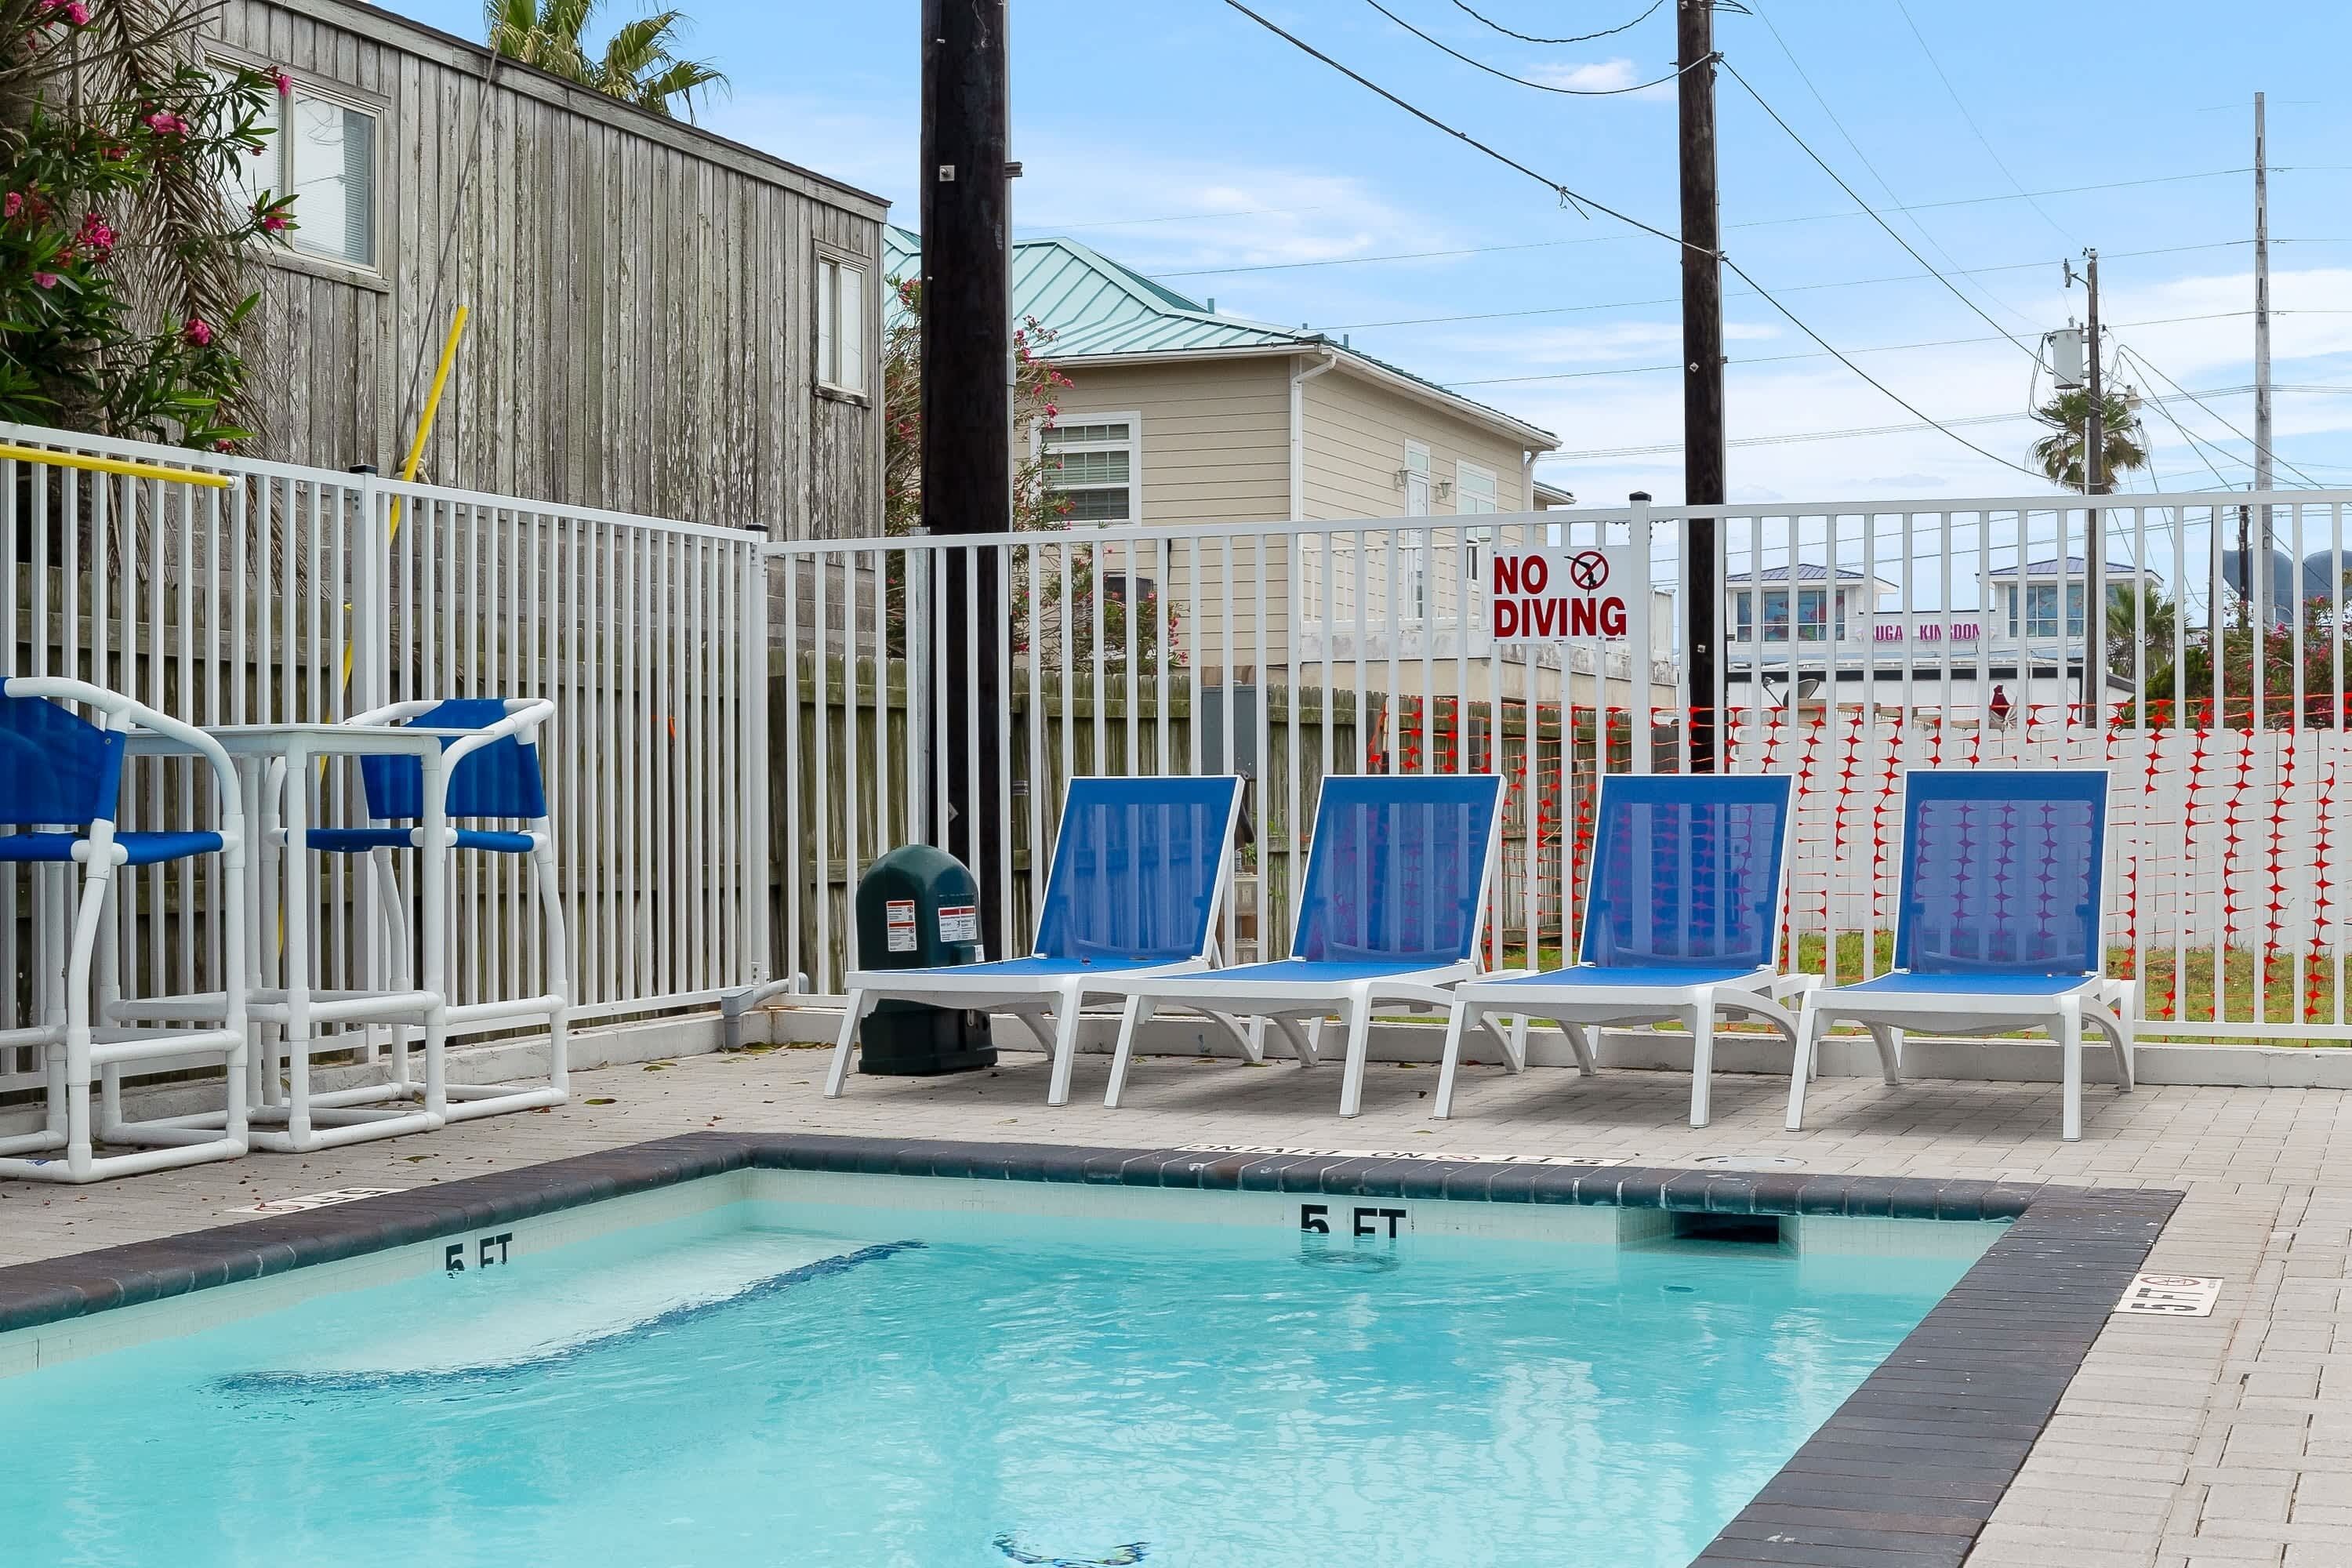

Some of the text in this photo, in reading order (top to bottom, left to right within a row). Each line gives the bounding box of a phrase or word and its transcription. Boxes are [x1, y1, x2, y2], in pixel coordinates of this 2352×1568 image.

[1494, 555, 1548, 594] NO
[1494, 597, 1627, 637] DIVING
[1873, 623, 1980, 641] UGA KINDOM
[1186, 1145, 1341, 1156] DIVING
[1301, 1203, 1406, 1239] 5 FT
[445, 1232, 513, 1273] 5 FT
[2130, 1287, 2204, 1312] 5 FT
